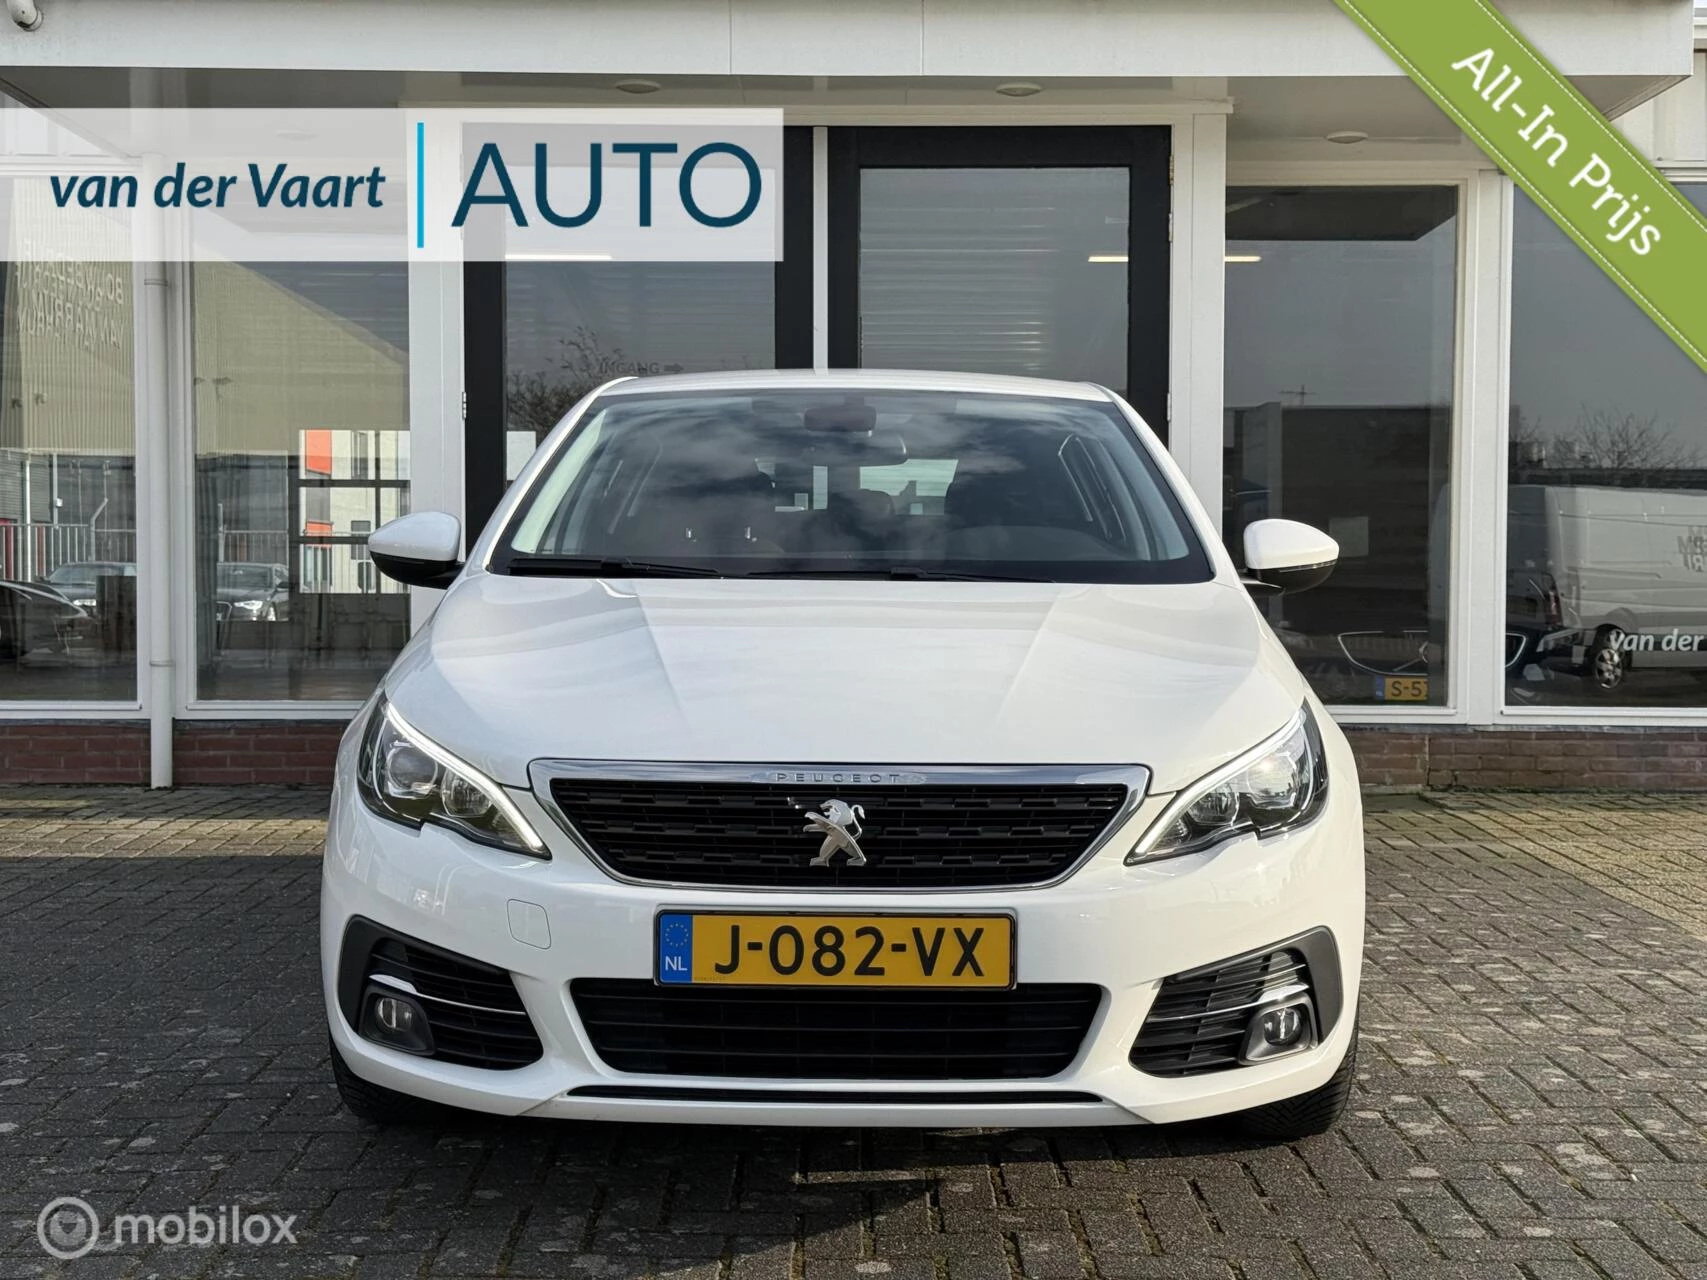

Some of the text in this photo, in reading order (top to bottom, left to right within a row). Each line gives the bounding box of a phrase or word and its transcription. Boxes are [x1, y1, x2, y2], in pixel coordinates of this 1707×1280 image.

[599, 361, 660, 375] INGANG
[1610, 628, 1704, 651] van der
[776, 773, 900, 783] PEUGEOT
[714, 924, 985, 977] J-082-VX
[664, 956, 688, 971] NL
